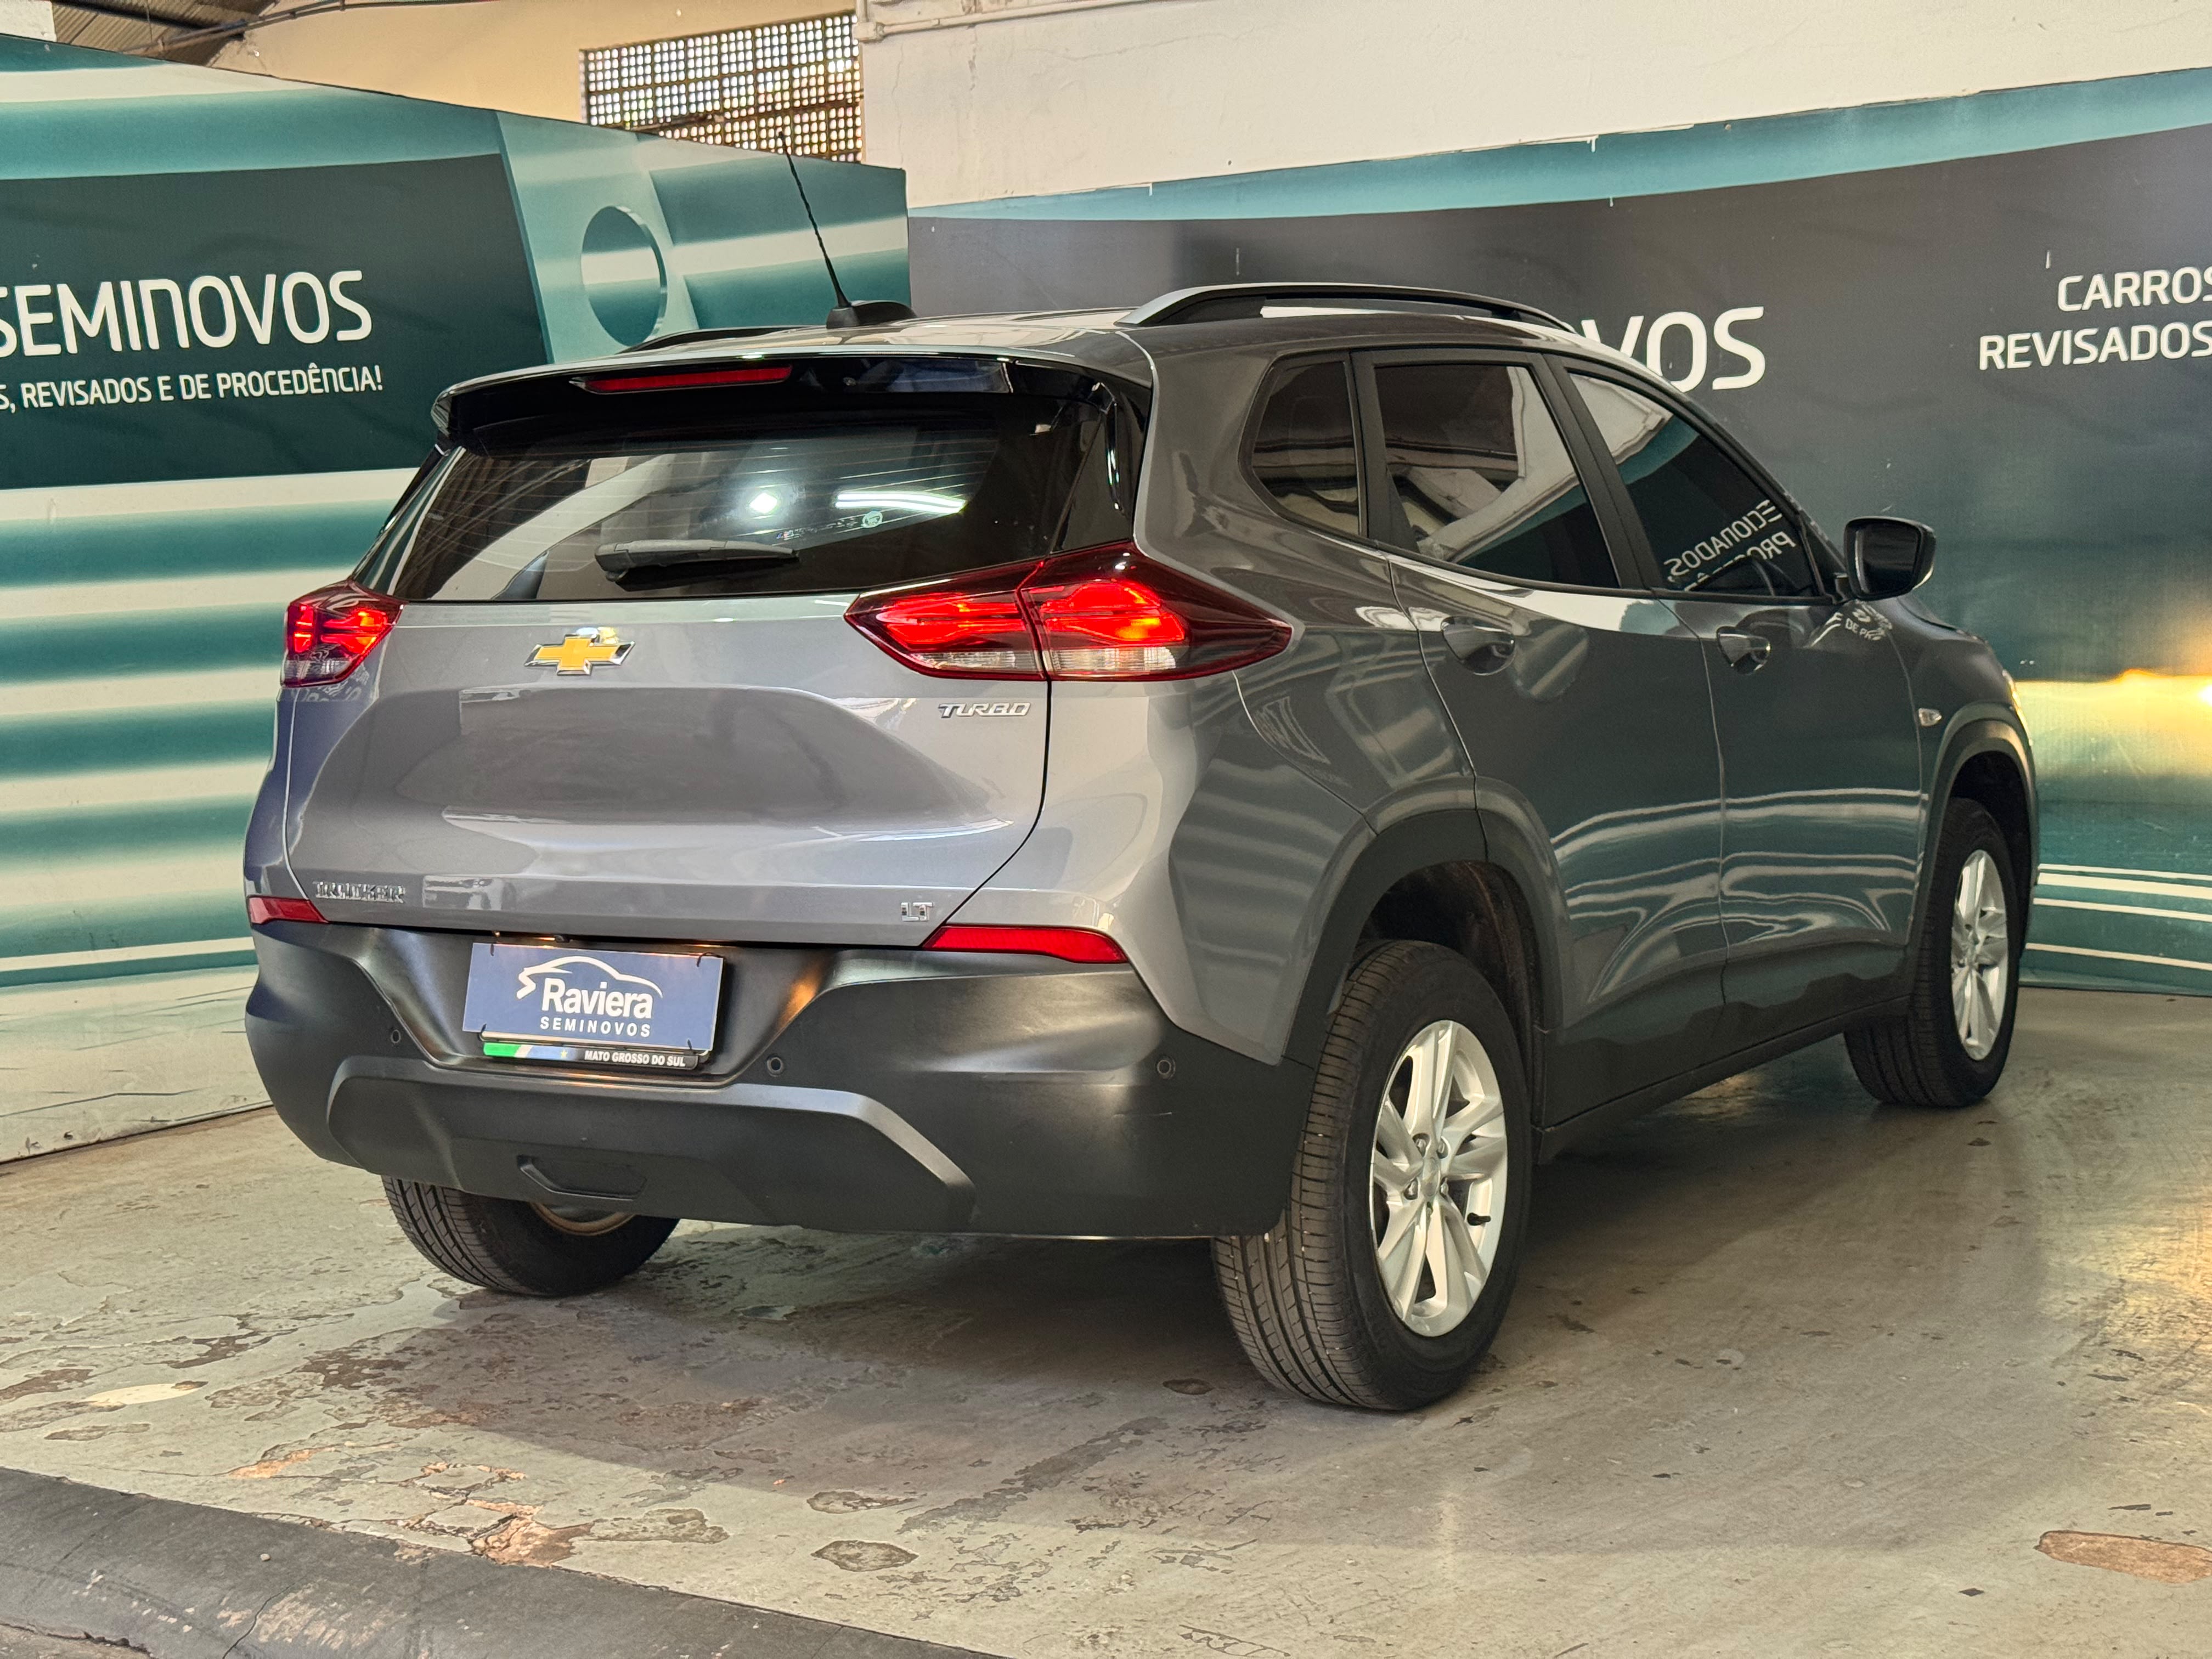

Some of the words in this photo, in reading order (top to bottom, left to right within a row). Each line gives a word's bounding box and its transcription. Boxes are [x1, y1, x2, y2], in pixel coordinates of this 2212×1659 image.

[1979, 320, 2212, 370] REVISADOS
[21, 377, 152, 408] REVISADOS
[157, 376, 174, 401] E
[179, 374, 212, 399] DE
[216, 362, 383, 398] PROCEDÊNCIA!
[938, 702, 1030, 718] TURBO
[901, 901, 934, 922] LT
[541, 978, 653, 1019] Raviera
[540, 1016, 651, 1037] SEMINOVOS
[584, 1050, 610, 1062] MATO
[612, 1052, 650, 1064] GROSSO
[651, 1054, 665, 1065] DO
[667, 1056, 686, 1067] SUL
